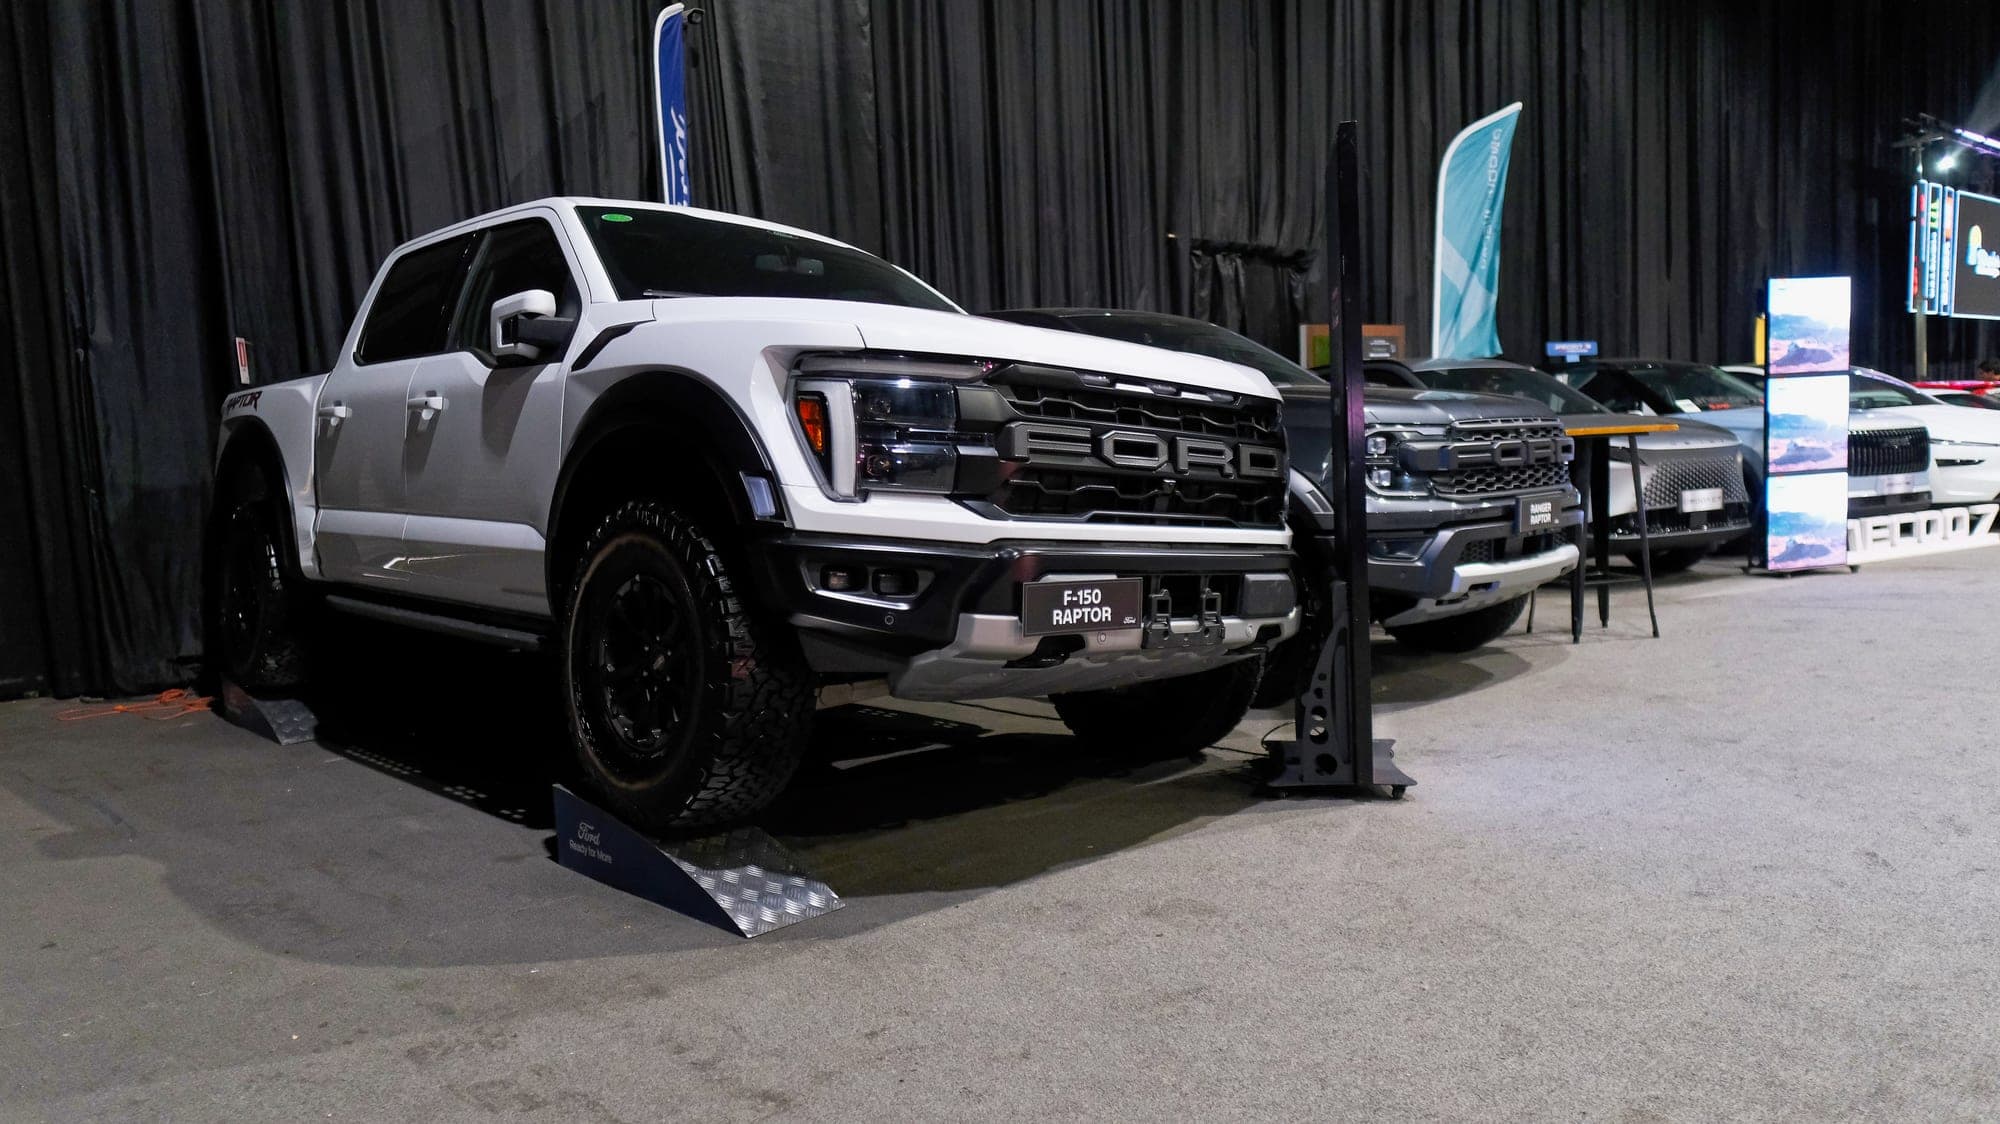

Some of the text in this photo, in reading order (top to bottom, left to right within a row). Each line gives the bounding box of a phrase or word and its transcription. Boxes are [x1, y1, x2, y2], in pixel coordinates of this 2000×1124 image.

[1004, 421, 1281, 479] FORD
[1530, 513, 1552, 525] RAPTOR
[1063, 588, 1102, 606] F-150
[1052, 606, 1112, 625] RAPTOR
[569, 839, 588, 856] Ready
